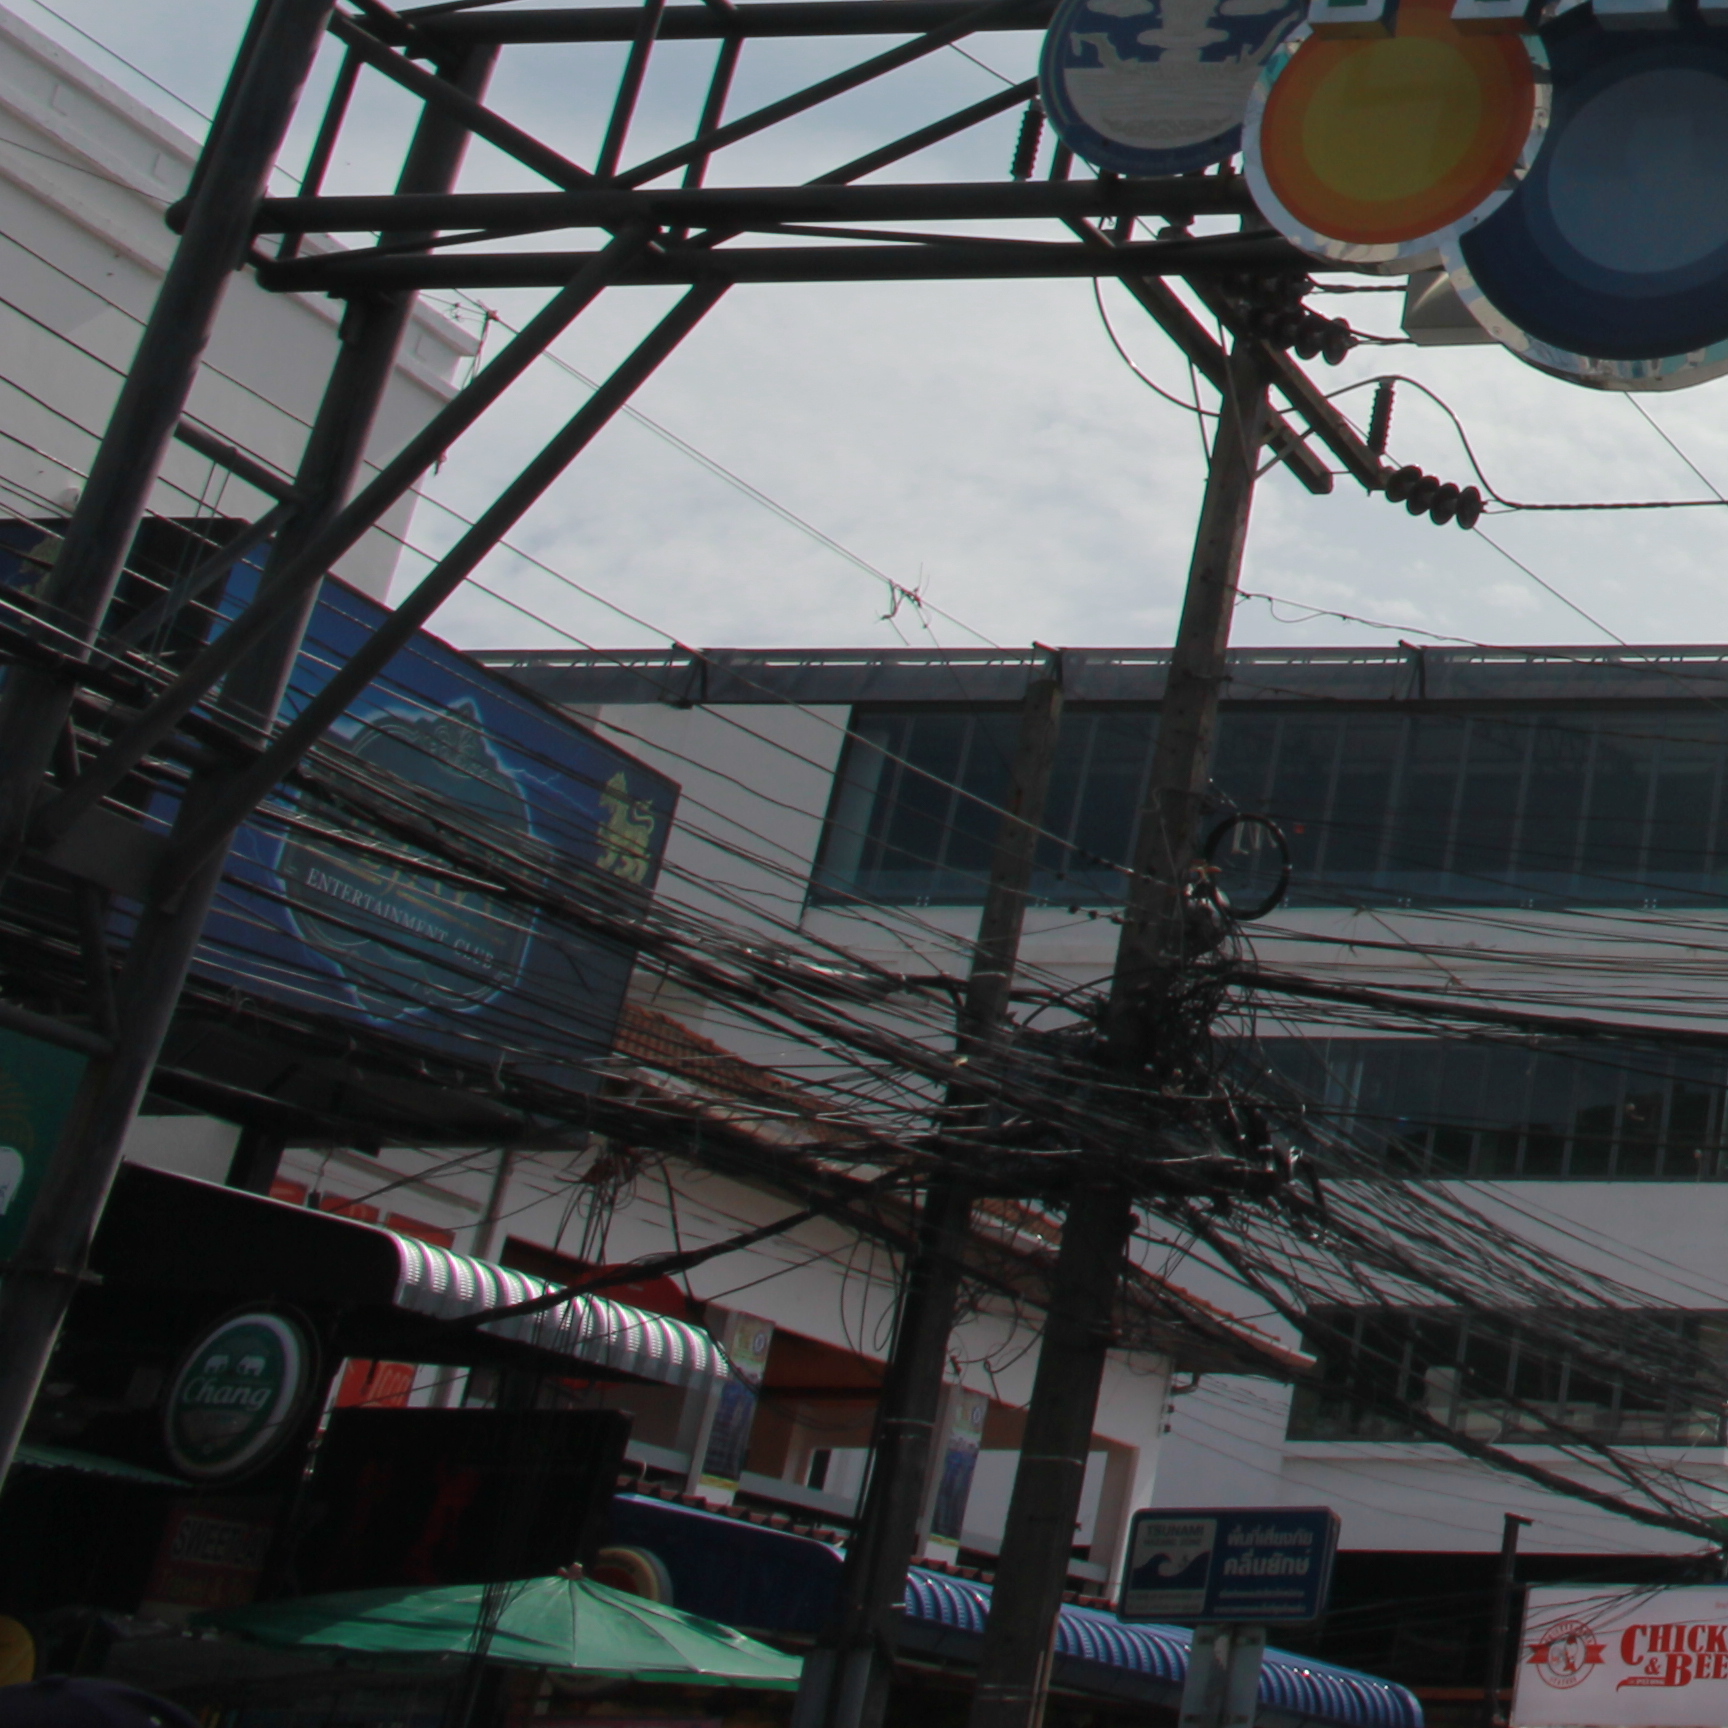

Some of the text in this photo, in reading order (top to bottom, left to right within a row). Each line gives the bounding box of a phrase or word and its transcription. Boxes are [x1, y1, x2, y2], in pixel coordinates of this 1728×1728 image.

[305, 867, 495, 970] ENTERTAINMENT CLUB
[180, 1376, 272, 1413] Chang
[1146, 1524, 1204, 1536] TSUNAMI
[1644, 1657, 1661, 1676] &
